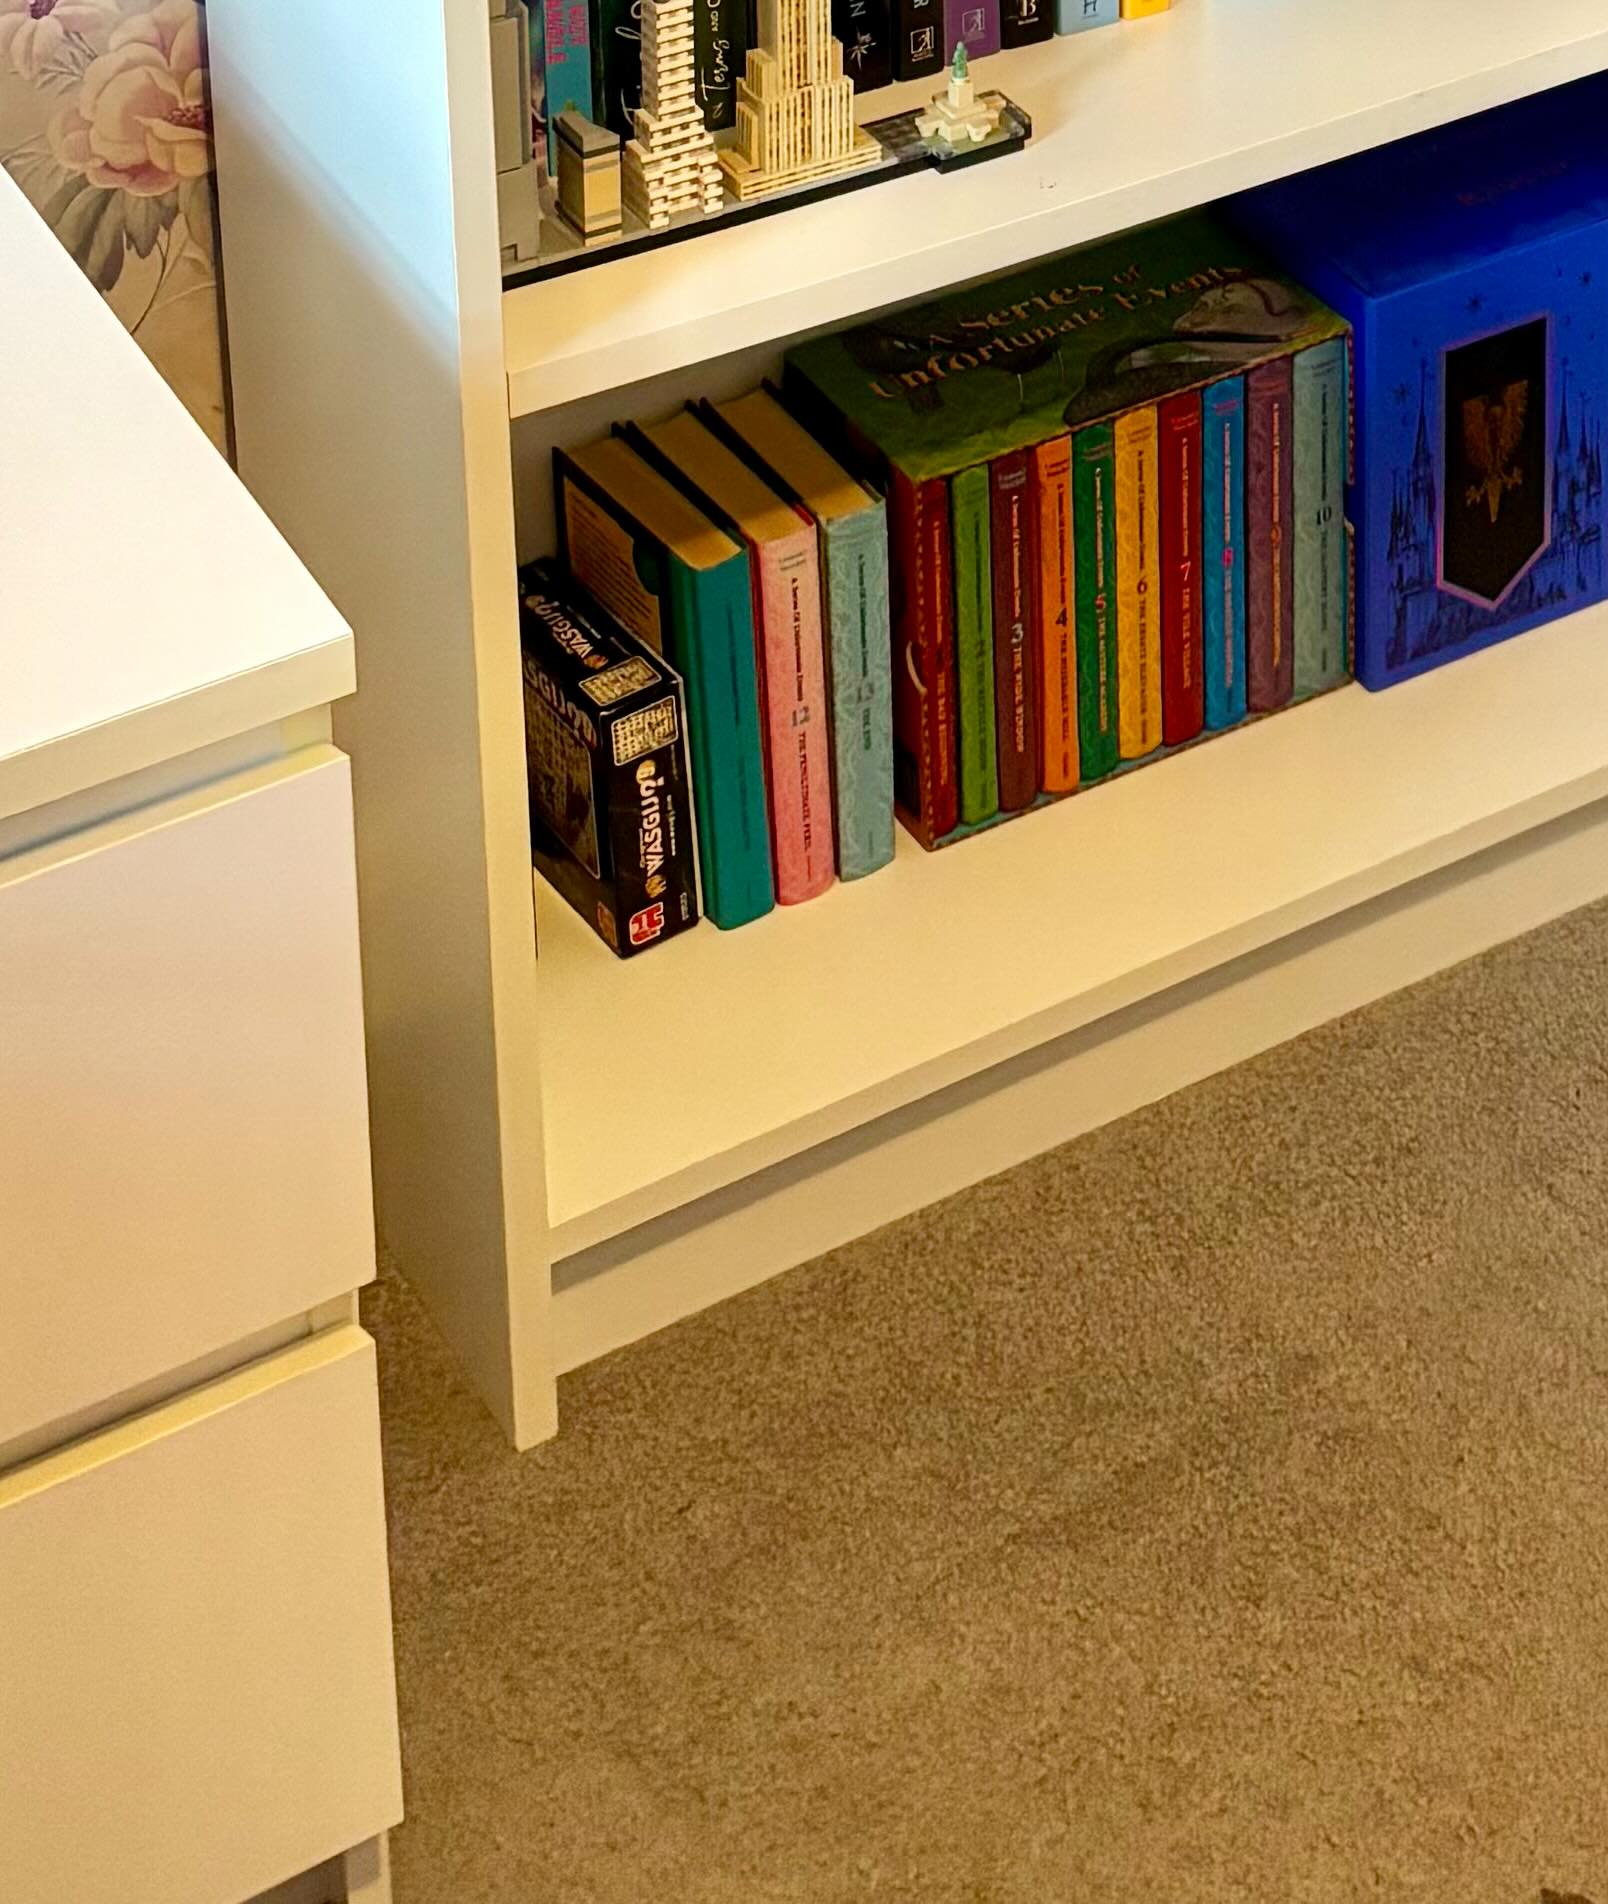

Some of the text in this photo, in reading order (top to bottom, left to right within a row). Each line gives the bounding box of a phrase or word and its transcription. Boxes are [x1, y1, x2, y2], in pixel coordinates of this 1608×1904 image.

[868, 307, 1105, 399] Unfortunate
[1317, 506, 1331, 525] 10
[1180, 561, 1191, 580] 7
[1056, 608, 1068, 626] 4
[1011, 623, 1024, 644] 3
